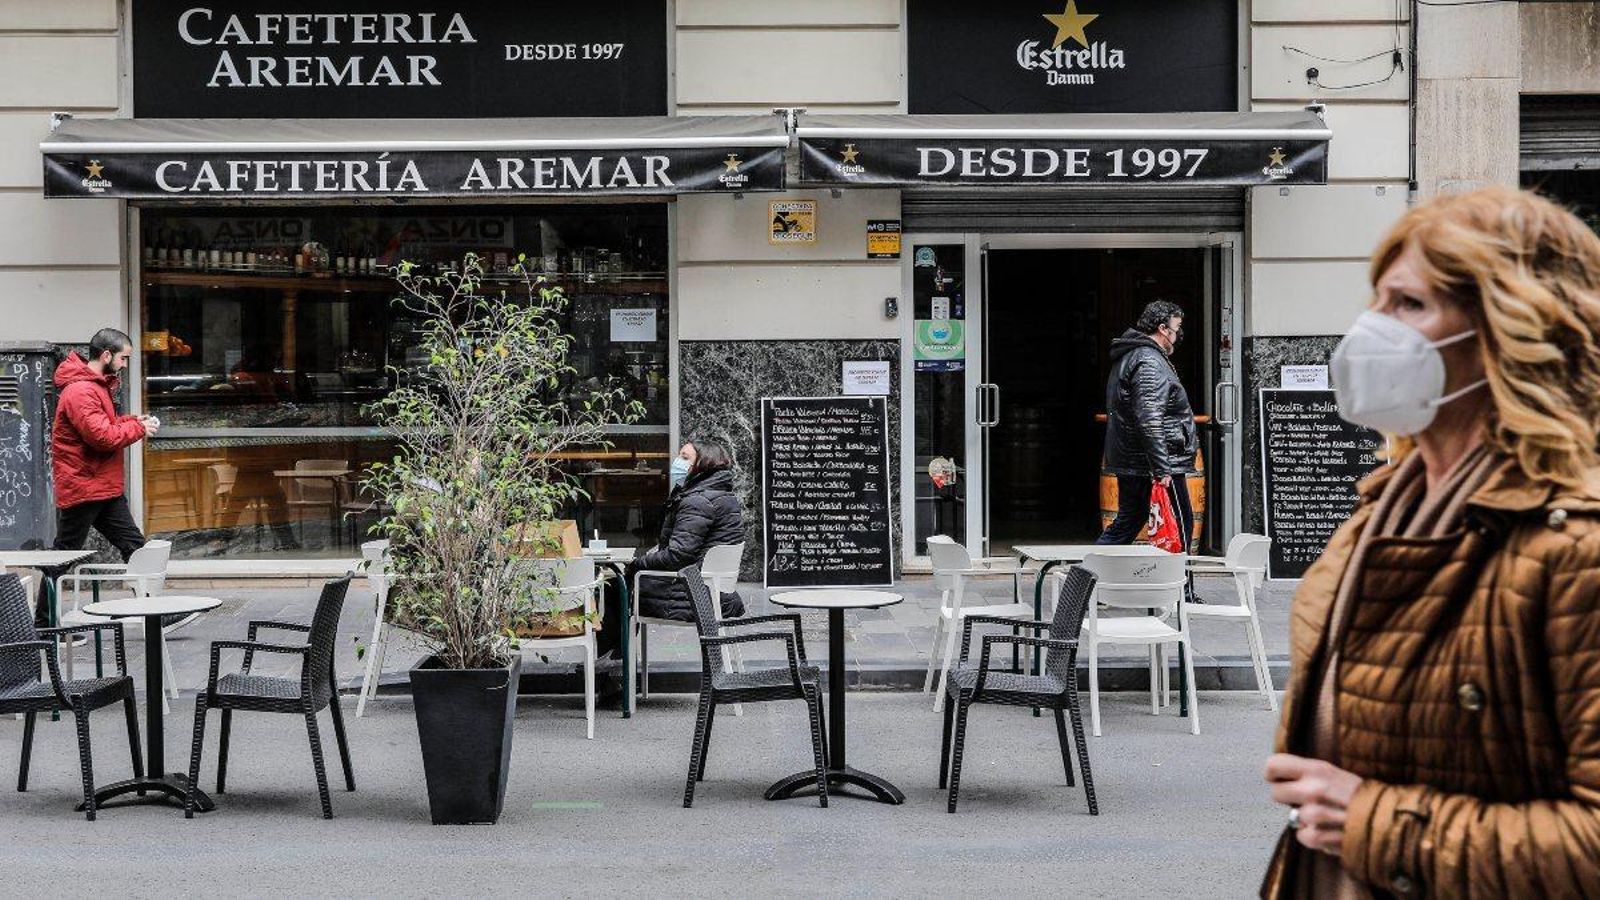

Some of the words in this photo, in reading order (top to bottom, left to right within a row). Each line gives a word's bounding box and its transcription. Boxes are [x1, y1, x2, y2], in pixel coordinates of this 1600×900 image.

[178, 7, 478, 46] CAFETERIA
[504, 43, 577, 61] DESDE
[582, 43, 624, 60] 1997
[1016, 39, 1126, 70] Estrella
[206, 50, 442, 88] AREMAR
[1046, 70, 1095, 86] Damm
[154, 151, 429, 193] CAFETERÍA
[460, 155, 676, 191] AREMAR
[917, 147, 1091, 179] DESDE
[1105, 146, 1209, 178] 1997
